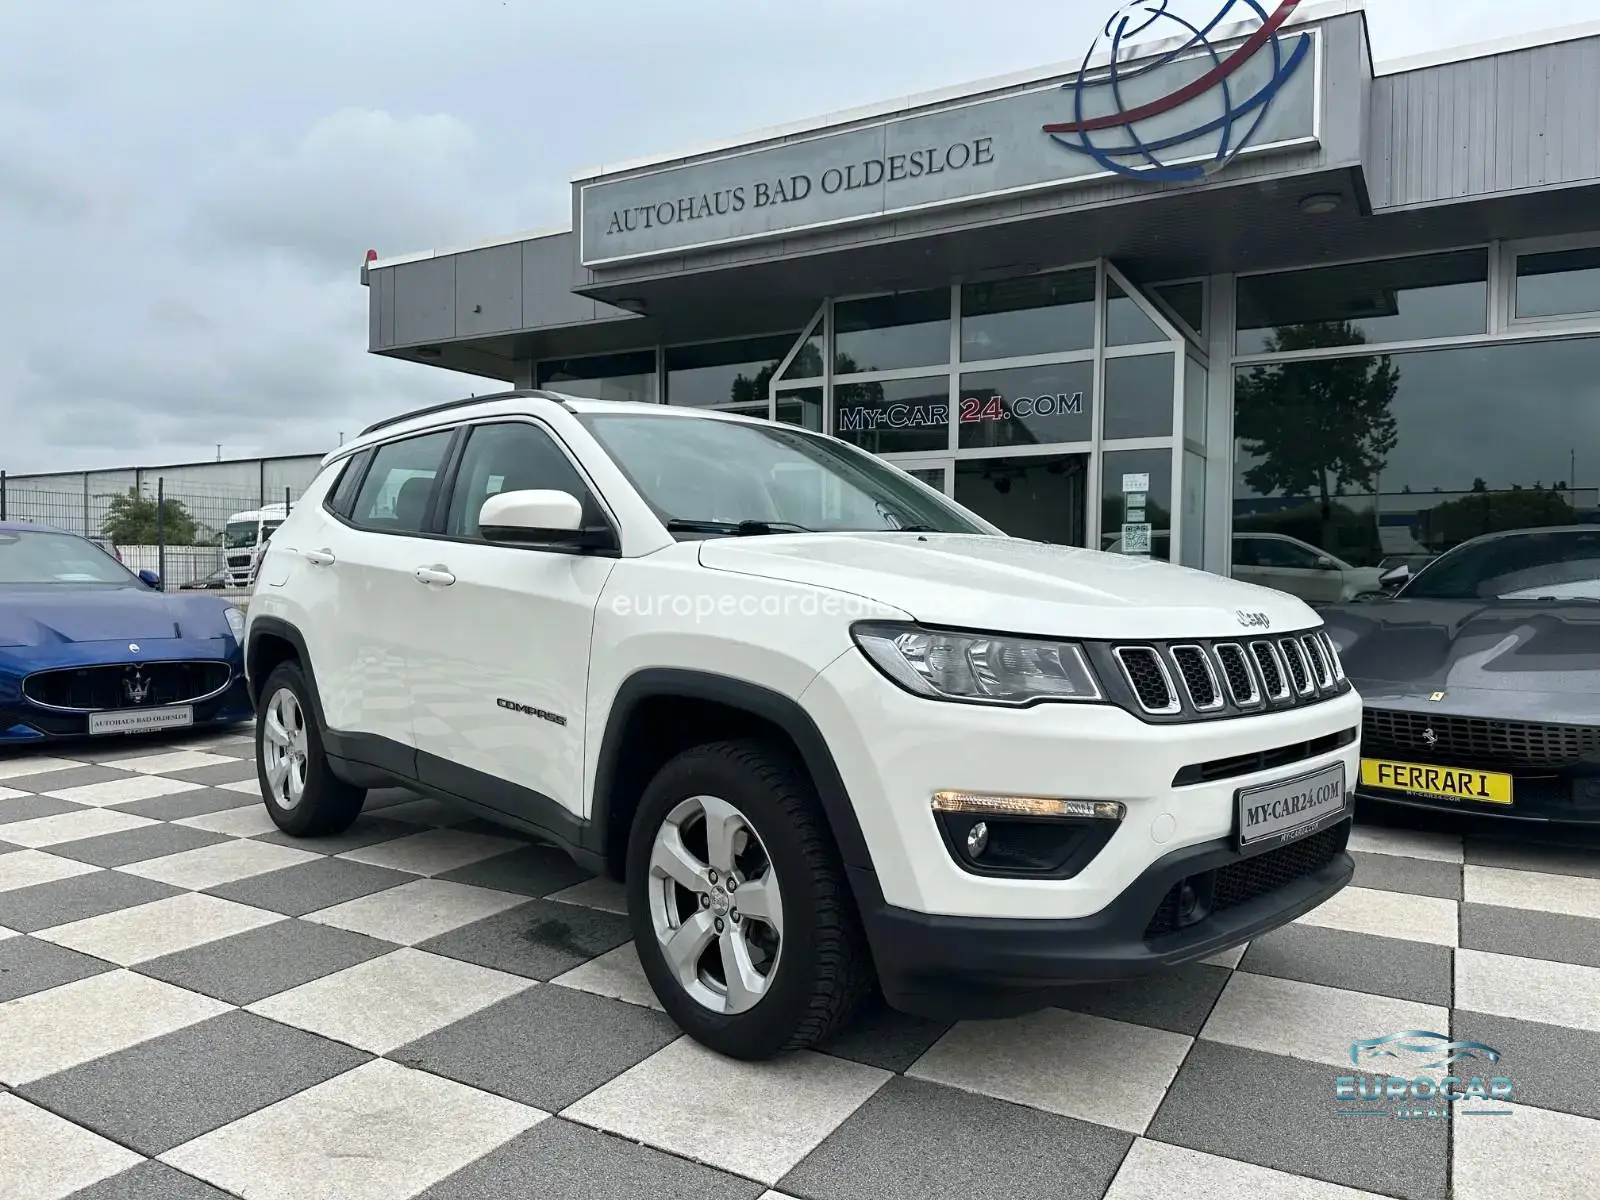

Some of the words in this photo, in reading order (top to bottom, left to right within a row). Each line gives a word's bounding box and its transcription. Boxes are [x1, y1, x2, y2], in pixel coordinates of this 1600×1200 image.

[607, 188, 746, 236] AUTOHAUS
[753, 175, 811, 209] BAD
[821, 137, 995, 195] OLDESLOE
[1236, 609, 1270, 629] Jeep
[94, 719, 135, 727] AUTOHAUS
[136, 716, 152, 724] BAD
[496, 698, 567, 726] COMPASS
[1378, 763, 1490, 797] FERRARI
[1246, 780, 1340, 828] MY-CAR24.COM
